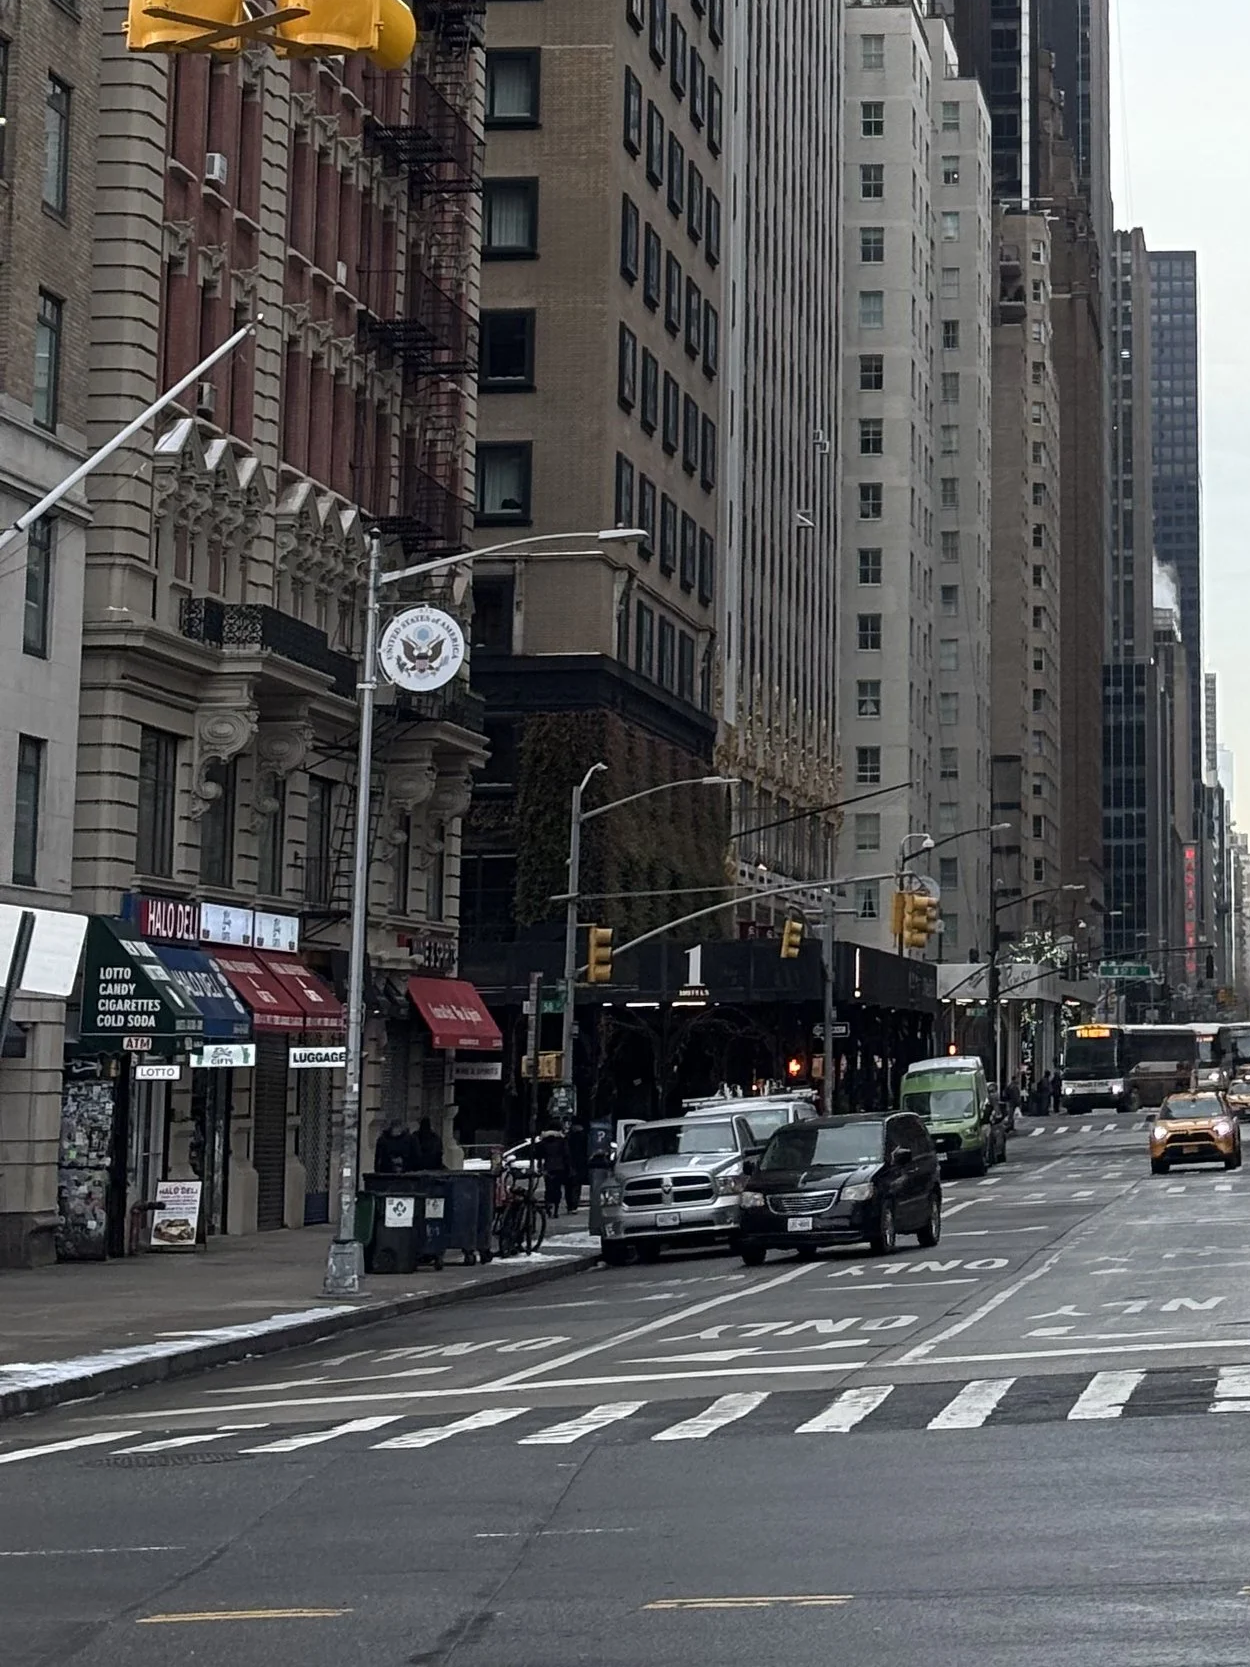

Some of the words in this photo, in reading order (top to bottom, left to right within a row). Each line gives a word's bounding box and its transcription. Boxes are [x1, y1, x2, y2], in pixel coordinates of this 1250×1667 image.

[387, 627, 401, 660] UNITED
[401, 615, 430, 629] STATES
[441, 621, 460, 659] AMERICA
[148, 899, 175, 938] HALO
[177, 903, 199, 940] DELI
[684, 944, 706, 987] 1
[100, 967, 132, 980] LOTTO
[99, 984, 136, 996] CANDY
[98, 999, 161, 1012] CIGARETTES
[97, 1015, 124, 1027] COLD
[127, 1015, 156, 1027] SODA
[125, 1037, 150, 1050] ATM
[292, 1052, 347, 1063] LUGGAGE
[140, 1067, 175, 1077] LOTTO
[828, 1256, 1009, 1280] ONLY
[659, 1314, 920, 1343] ONLY
